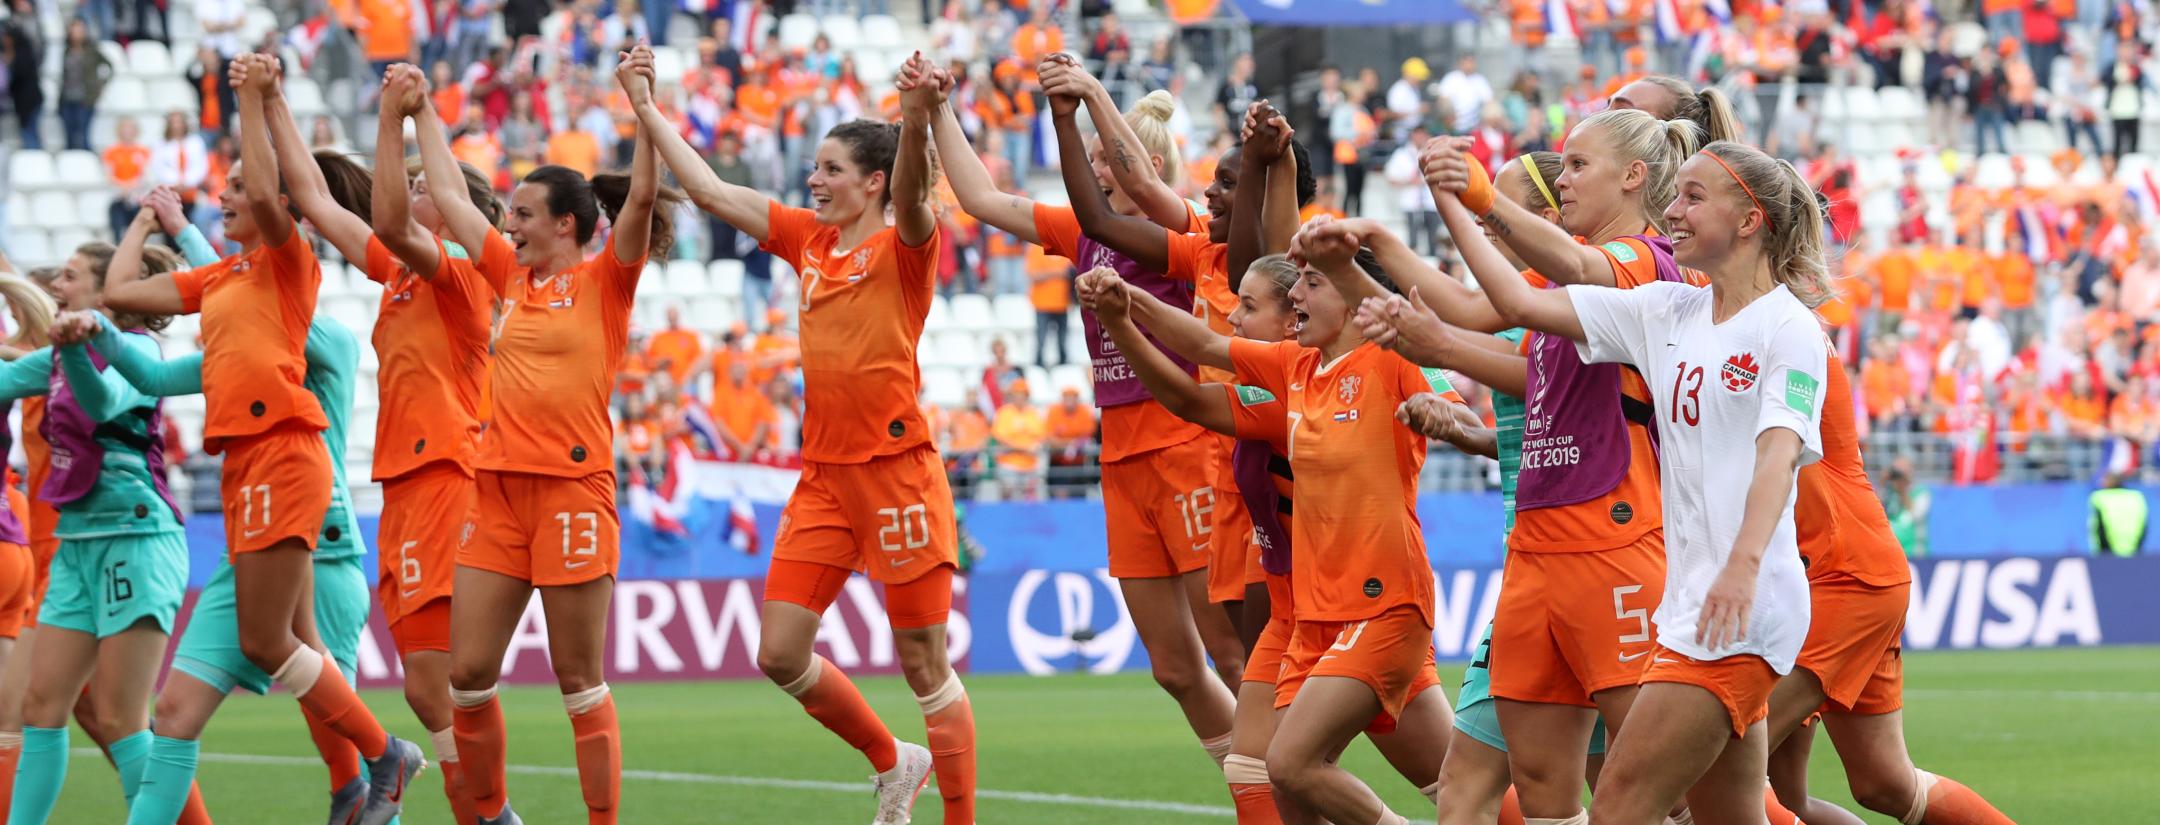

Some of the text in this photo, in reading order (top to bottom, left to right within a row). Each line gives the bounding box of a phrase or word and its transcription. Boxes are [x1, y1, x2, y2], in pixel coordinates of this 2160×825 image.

[1672, 361, 1704, 427] 13
[1722, 363, 1757, 381] CANADA
[1543, 446, 1580, 467] 2019
[1556, 435, 1574, 446] CUP
[240, 483, 270, 526] 11
[1174, 485, 1215, 537] 18
[555, 511, 597, 555] 13
[877, 503, 929, 551] 20
[104, 560, 132, 604] 16
[401, 540, 421, 584] 6
[1613, 584, 1650, 643] 5
[1905, 557, 2102, 649] VISA
[500, 577, 972, 674] ARWAYS
